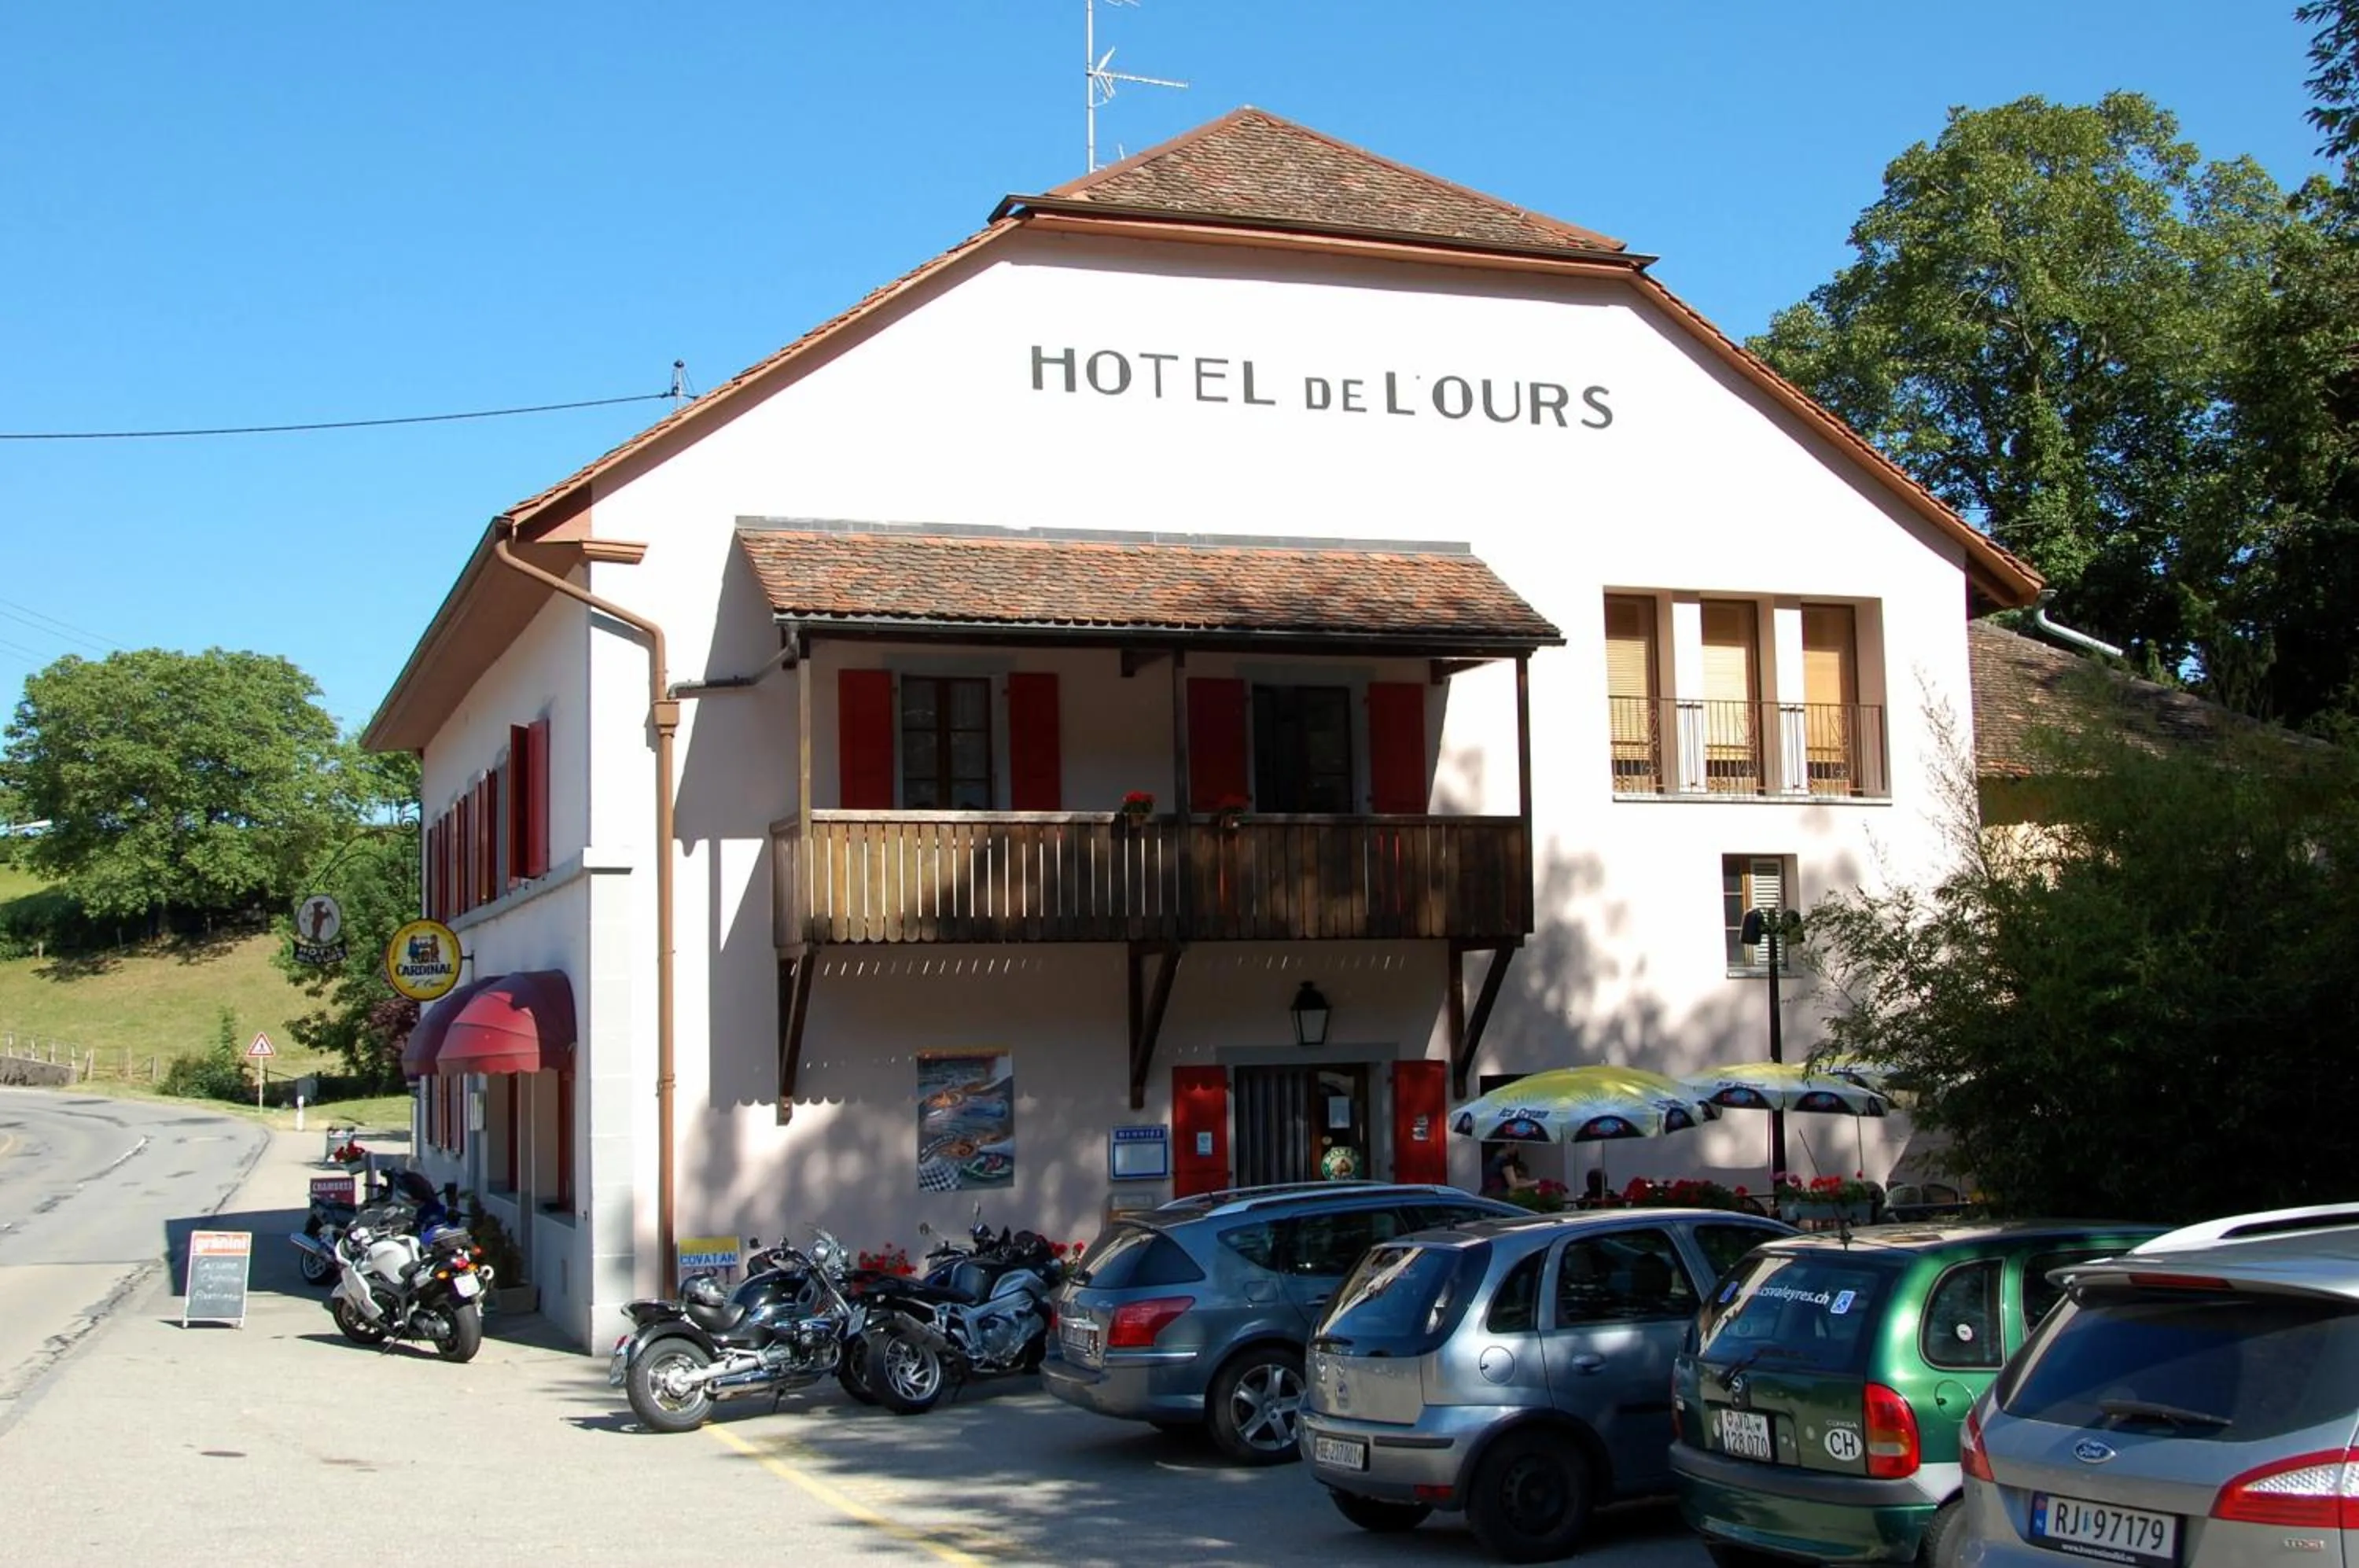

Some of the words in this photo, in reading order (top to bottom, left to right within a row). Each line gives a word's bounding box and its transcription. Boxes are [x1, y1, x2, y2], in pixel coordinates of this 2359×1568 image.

[1032, 346, 1275, 405] HOTEL
[1305, 377, 1367, 412] DE
[396, 963, 454, 976] CARDINAL
[1831, 1432, 1856, 1456] CH
[2055, 1503, 2080, 1535] RJ
[2094, 1509, 2164, 1550] 97179
